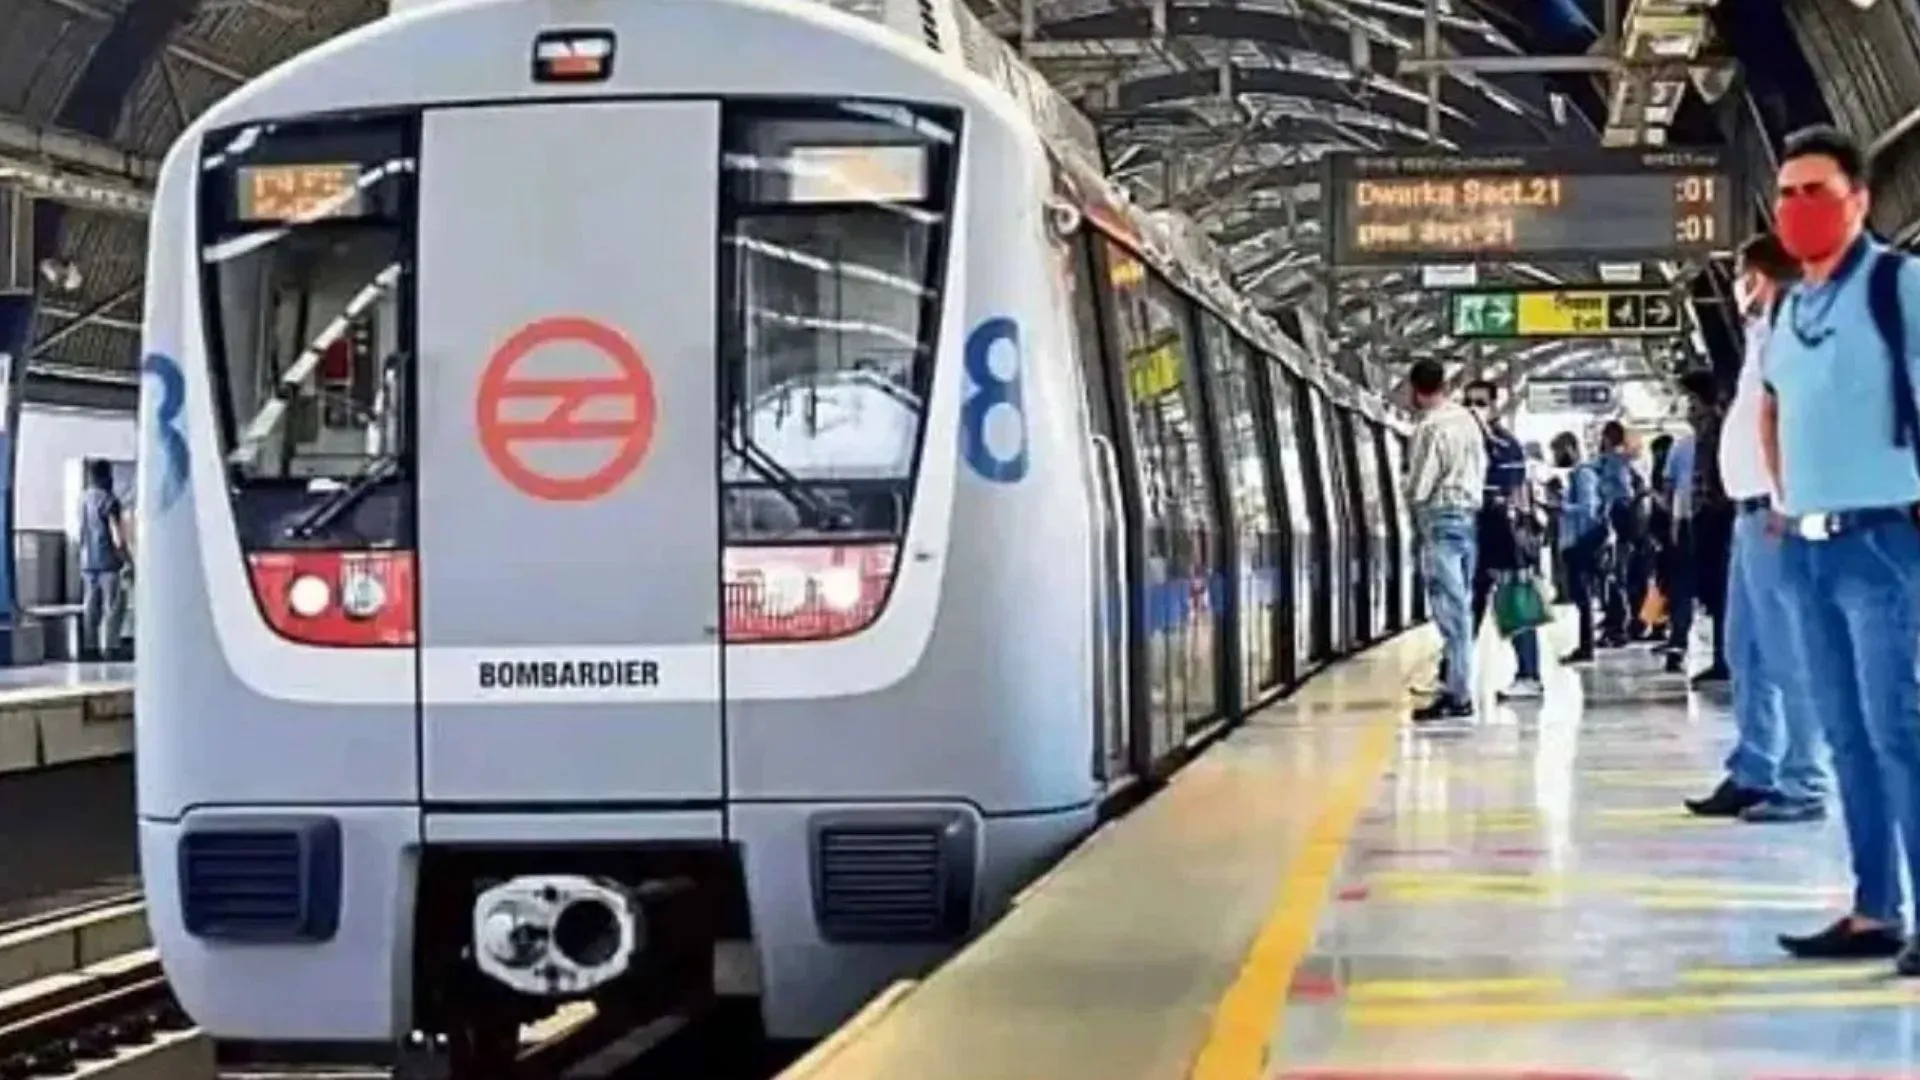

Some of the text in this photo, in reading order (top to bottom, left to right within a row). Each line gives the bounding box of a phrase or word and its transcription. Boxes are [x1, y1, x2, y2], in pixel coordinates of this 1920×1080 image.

[1357, 180, 1455, 207] Dwarka
[958, 315, 1029, 483] 8
[478, 660, 660, 689] BOMBARDIER
